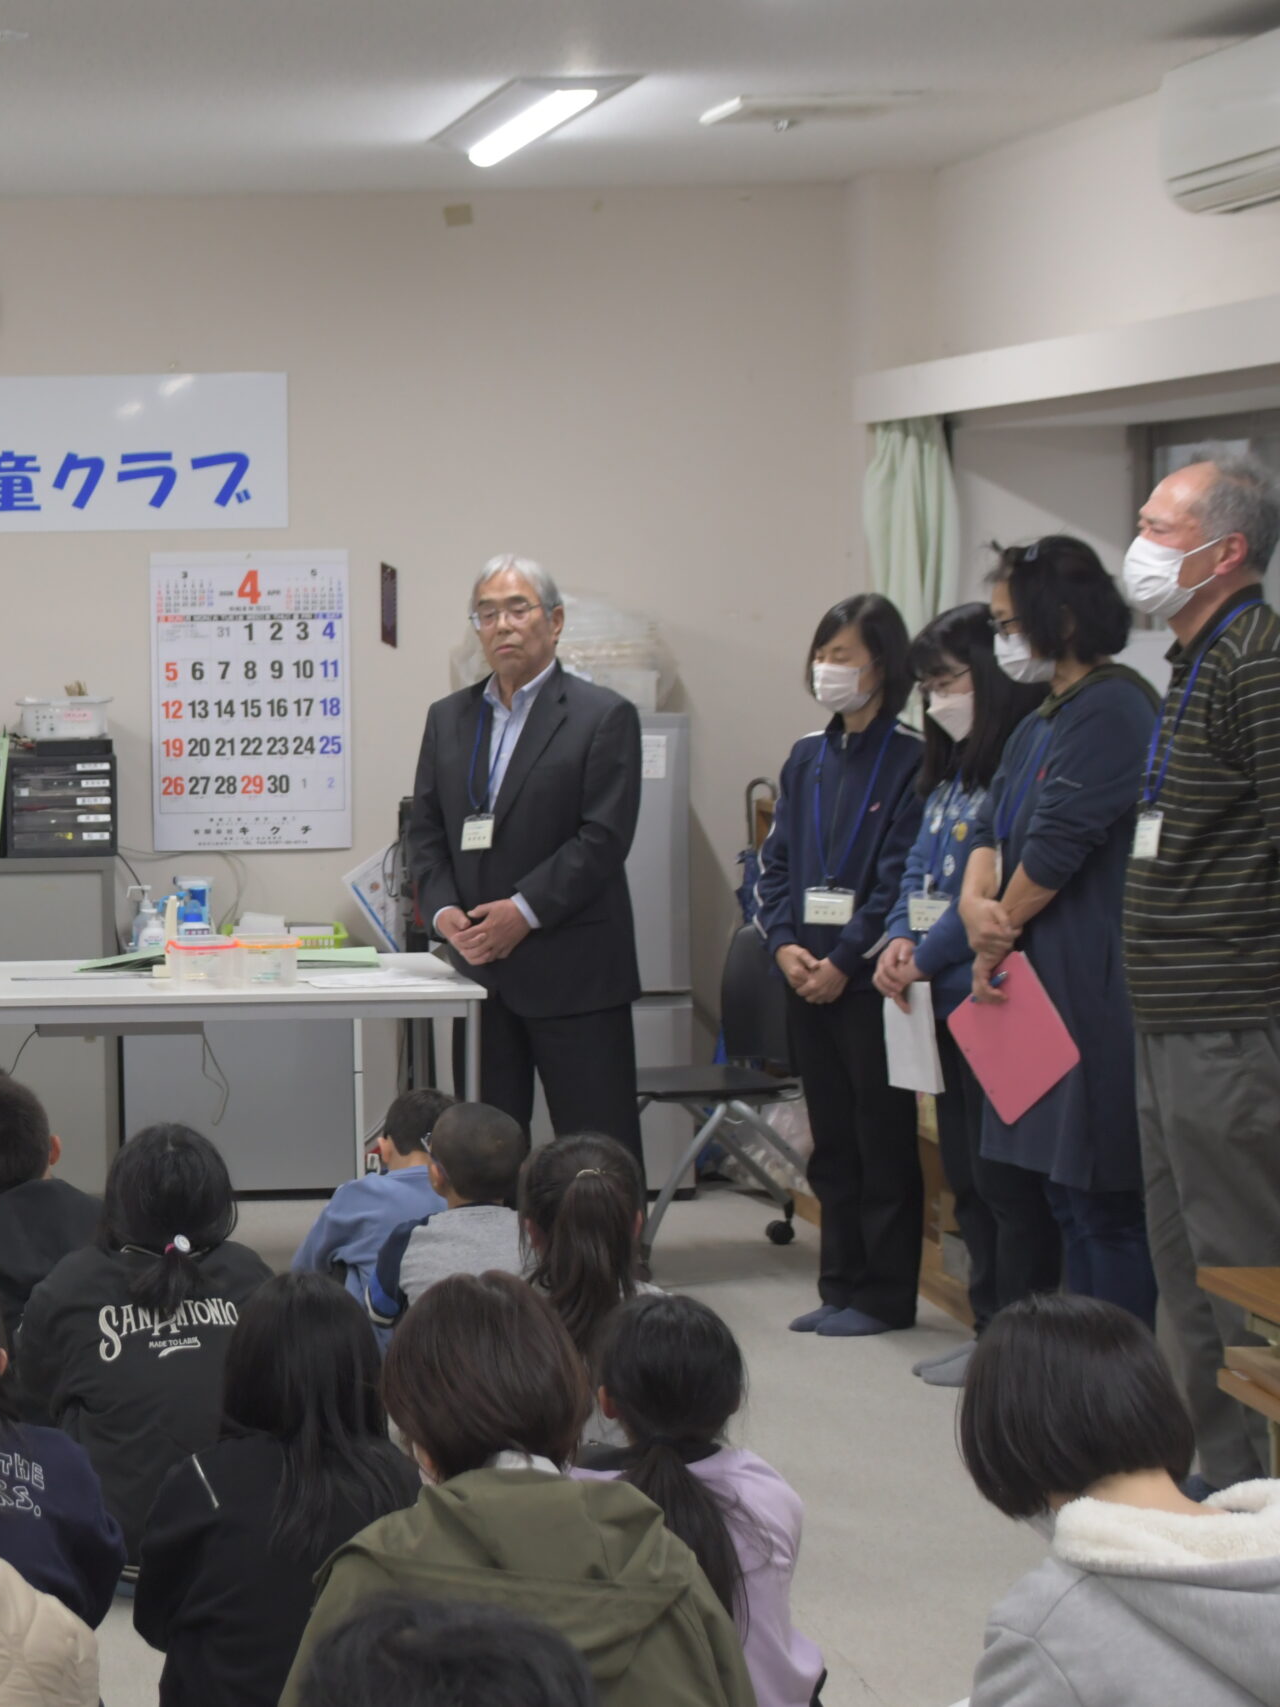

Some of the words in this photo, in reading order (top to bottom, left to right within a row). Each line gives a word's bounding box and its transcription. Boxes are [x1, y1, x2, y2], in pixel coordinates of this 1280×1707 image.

[237, 570, 261, 604] 4
[245, 623, 253, 641] 1
[270, 622, 282, 640] 2
[296, 621, 309, 640] 3
[323, 621, 335, 639] 4
[166, 662, 178, 681] 5
[192, 662, 204, 680] 6
[218, 661, 230, 680] 7
[244, 661, 256, 679] 8
[271, 660, 283, 679] 9
[293, 660, 313, 679] 10
[320, 660, 338, 678] 11
[162, 700, 182, 719] 12
[188, 700, 208, 718] 13
[215, 700, 235, 718] 14
[241, 699, 261, 718] 15
[267, 699, 288, 717] 16
[294, 698, 314, 716] 17
[320, 698, 340, 716] 18
[162, 738, 183, 758] 19
[188, 738, 210, 757] 20
[215, 738, 234, 756] 21
[241, 737, 262, 756] 22
[267, 737, 289, 755] 23
[293, 736, 315, 755] 24
[320, 736, 341, 754] 25
[162, 777, 184, 795] 26
[189, 776, 210, 795] 27
[215, 776, 237, 794] 28
[241, 776, 263, 794] 29
[268, 775, 289, 793] 30
